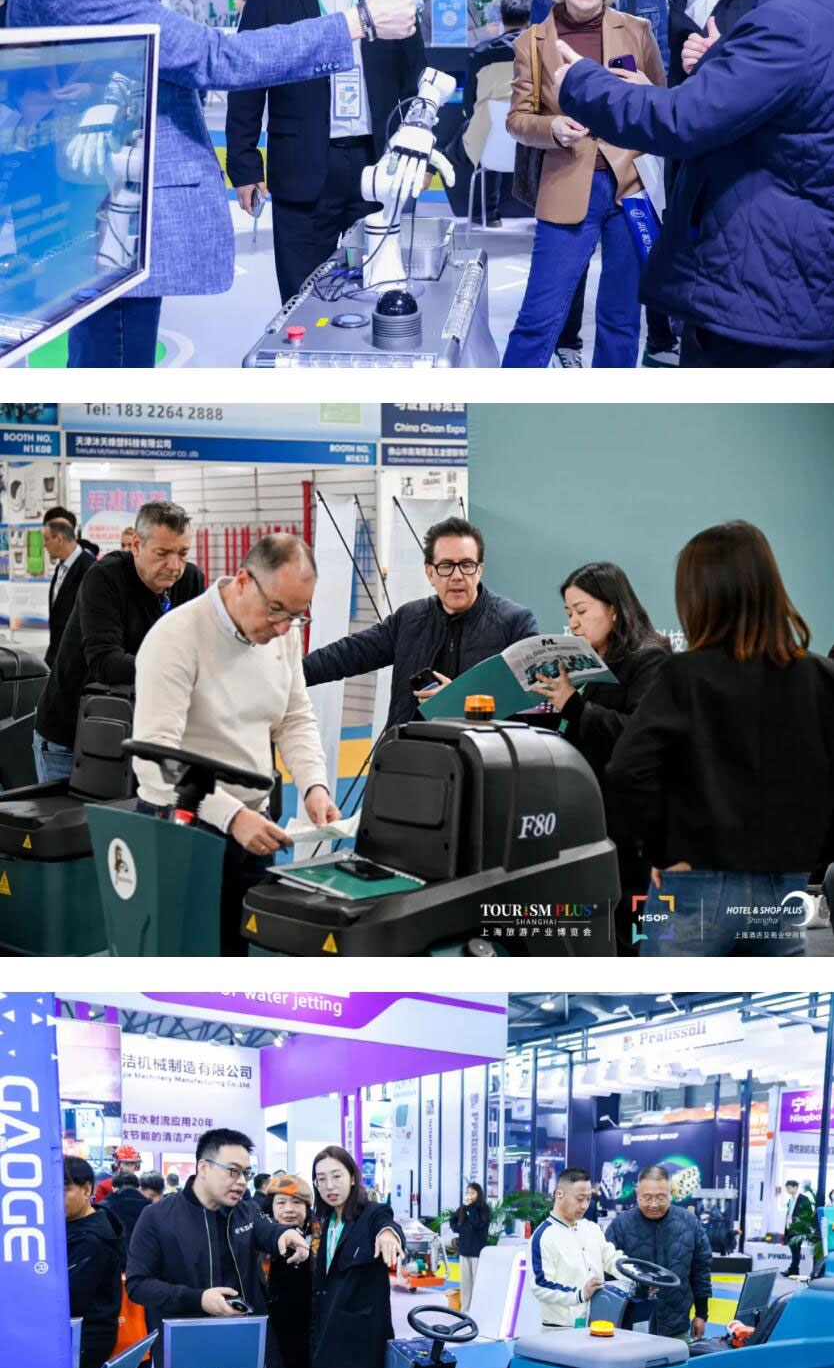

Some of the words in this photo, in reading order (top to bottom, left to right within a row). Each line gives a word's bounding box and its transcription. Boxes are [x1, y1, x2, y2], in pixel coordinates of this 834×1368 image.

[86, 403, 111, 416] Tel:
[116, 404, 142, 417] 183
[147, 405, 184, 419] 2264
[188, 407, 223, 421] 2888
[3, 432, 35, 442] BOOTH
[36, 434, 52, 443] NO.
[394, 422, 420, 432] China
[421, 423, 445, 433] Clean
[446, 424, 466, 435] Expo
[518, 812, 556, 839] F80
[292, 994, 342, 1017] jetting
[122, 1052, 253, 1080] 洁机械制造有限公司
[790, 1113, 822, 1124] Ningbo
[0, 1075, 46, 1262] GAOGE
